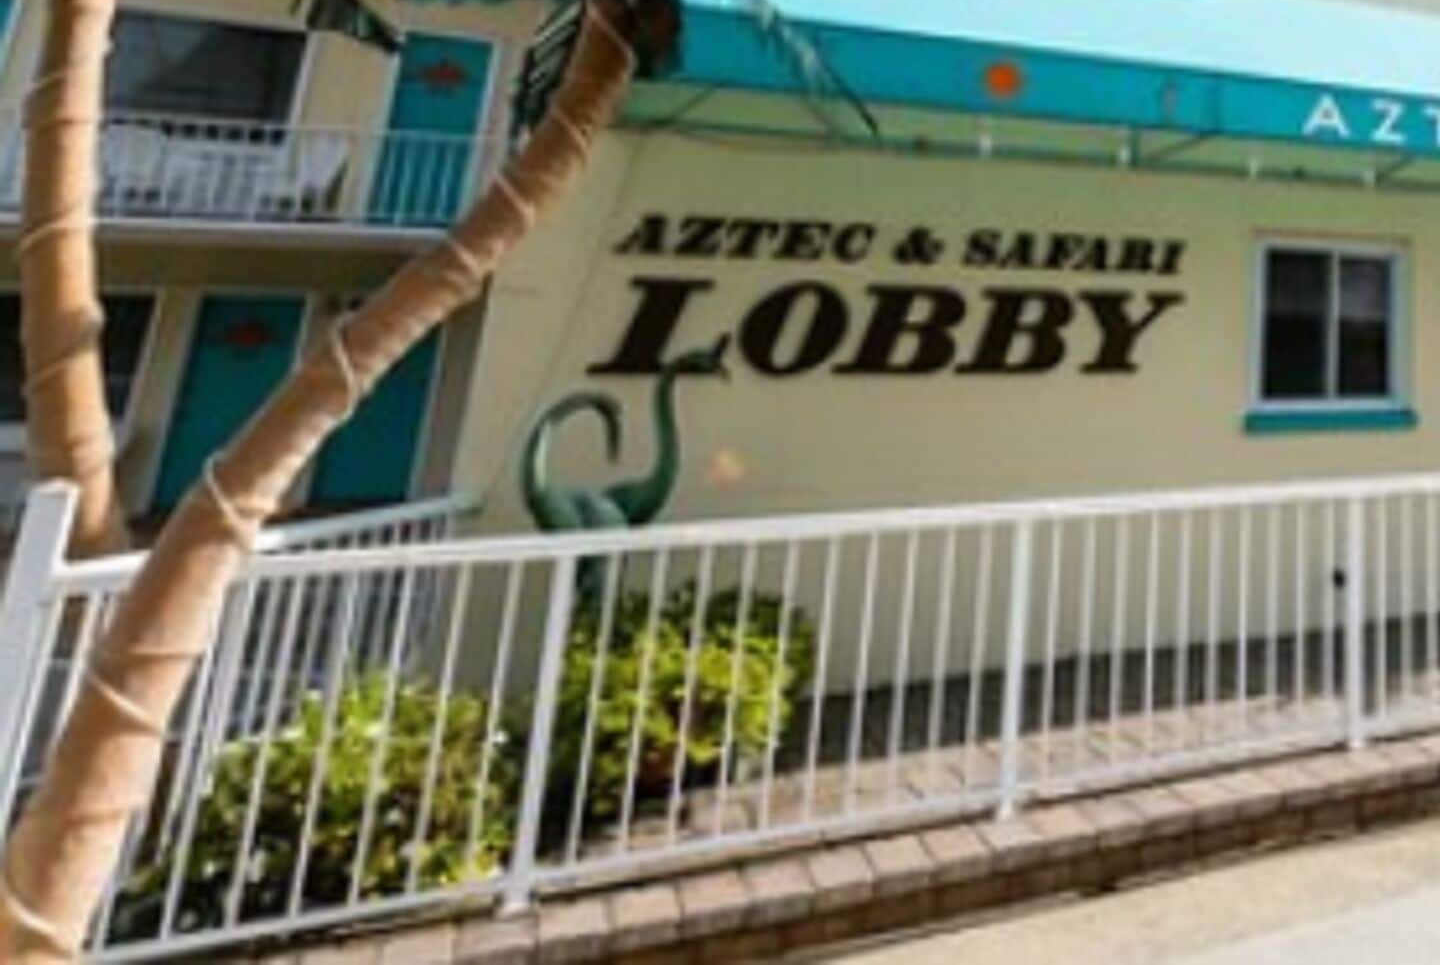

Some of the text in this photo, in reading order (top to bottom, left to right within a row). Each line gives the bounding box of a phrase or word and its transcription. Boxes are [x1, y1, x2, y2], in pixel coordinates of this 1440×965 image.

[613, 213, 1187, 276] AZTEC & SAFARI
[586, 276, 1186, 378] LOBBY
